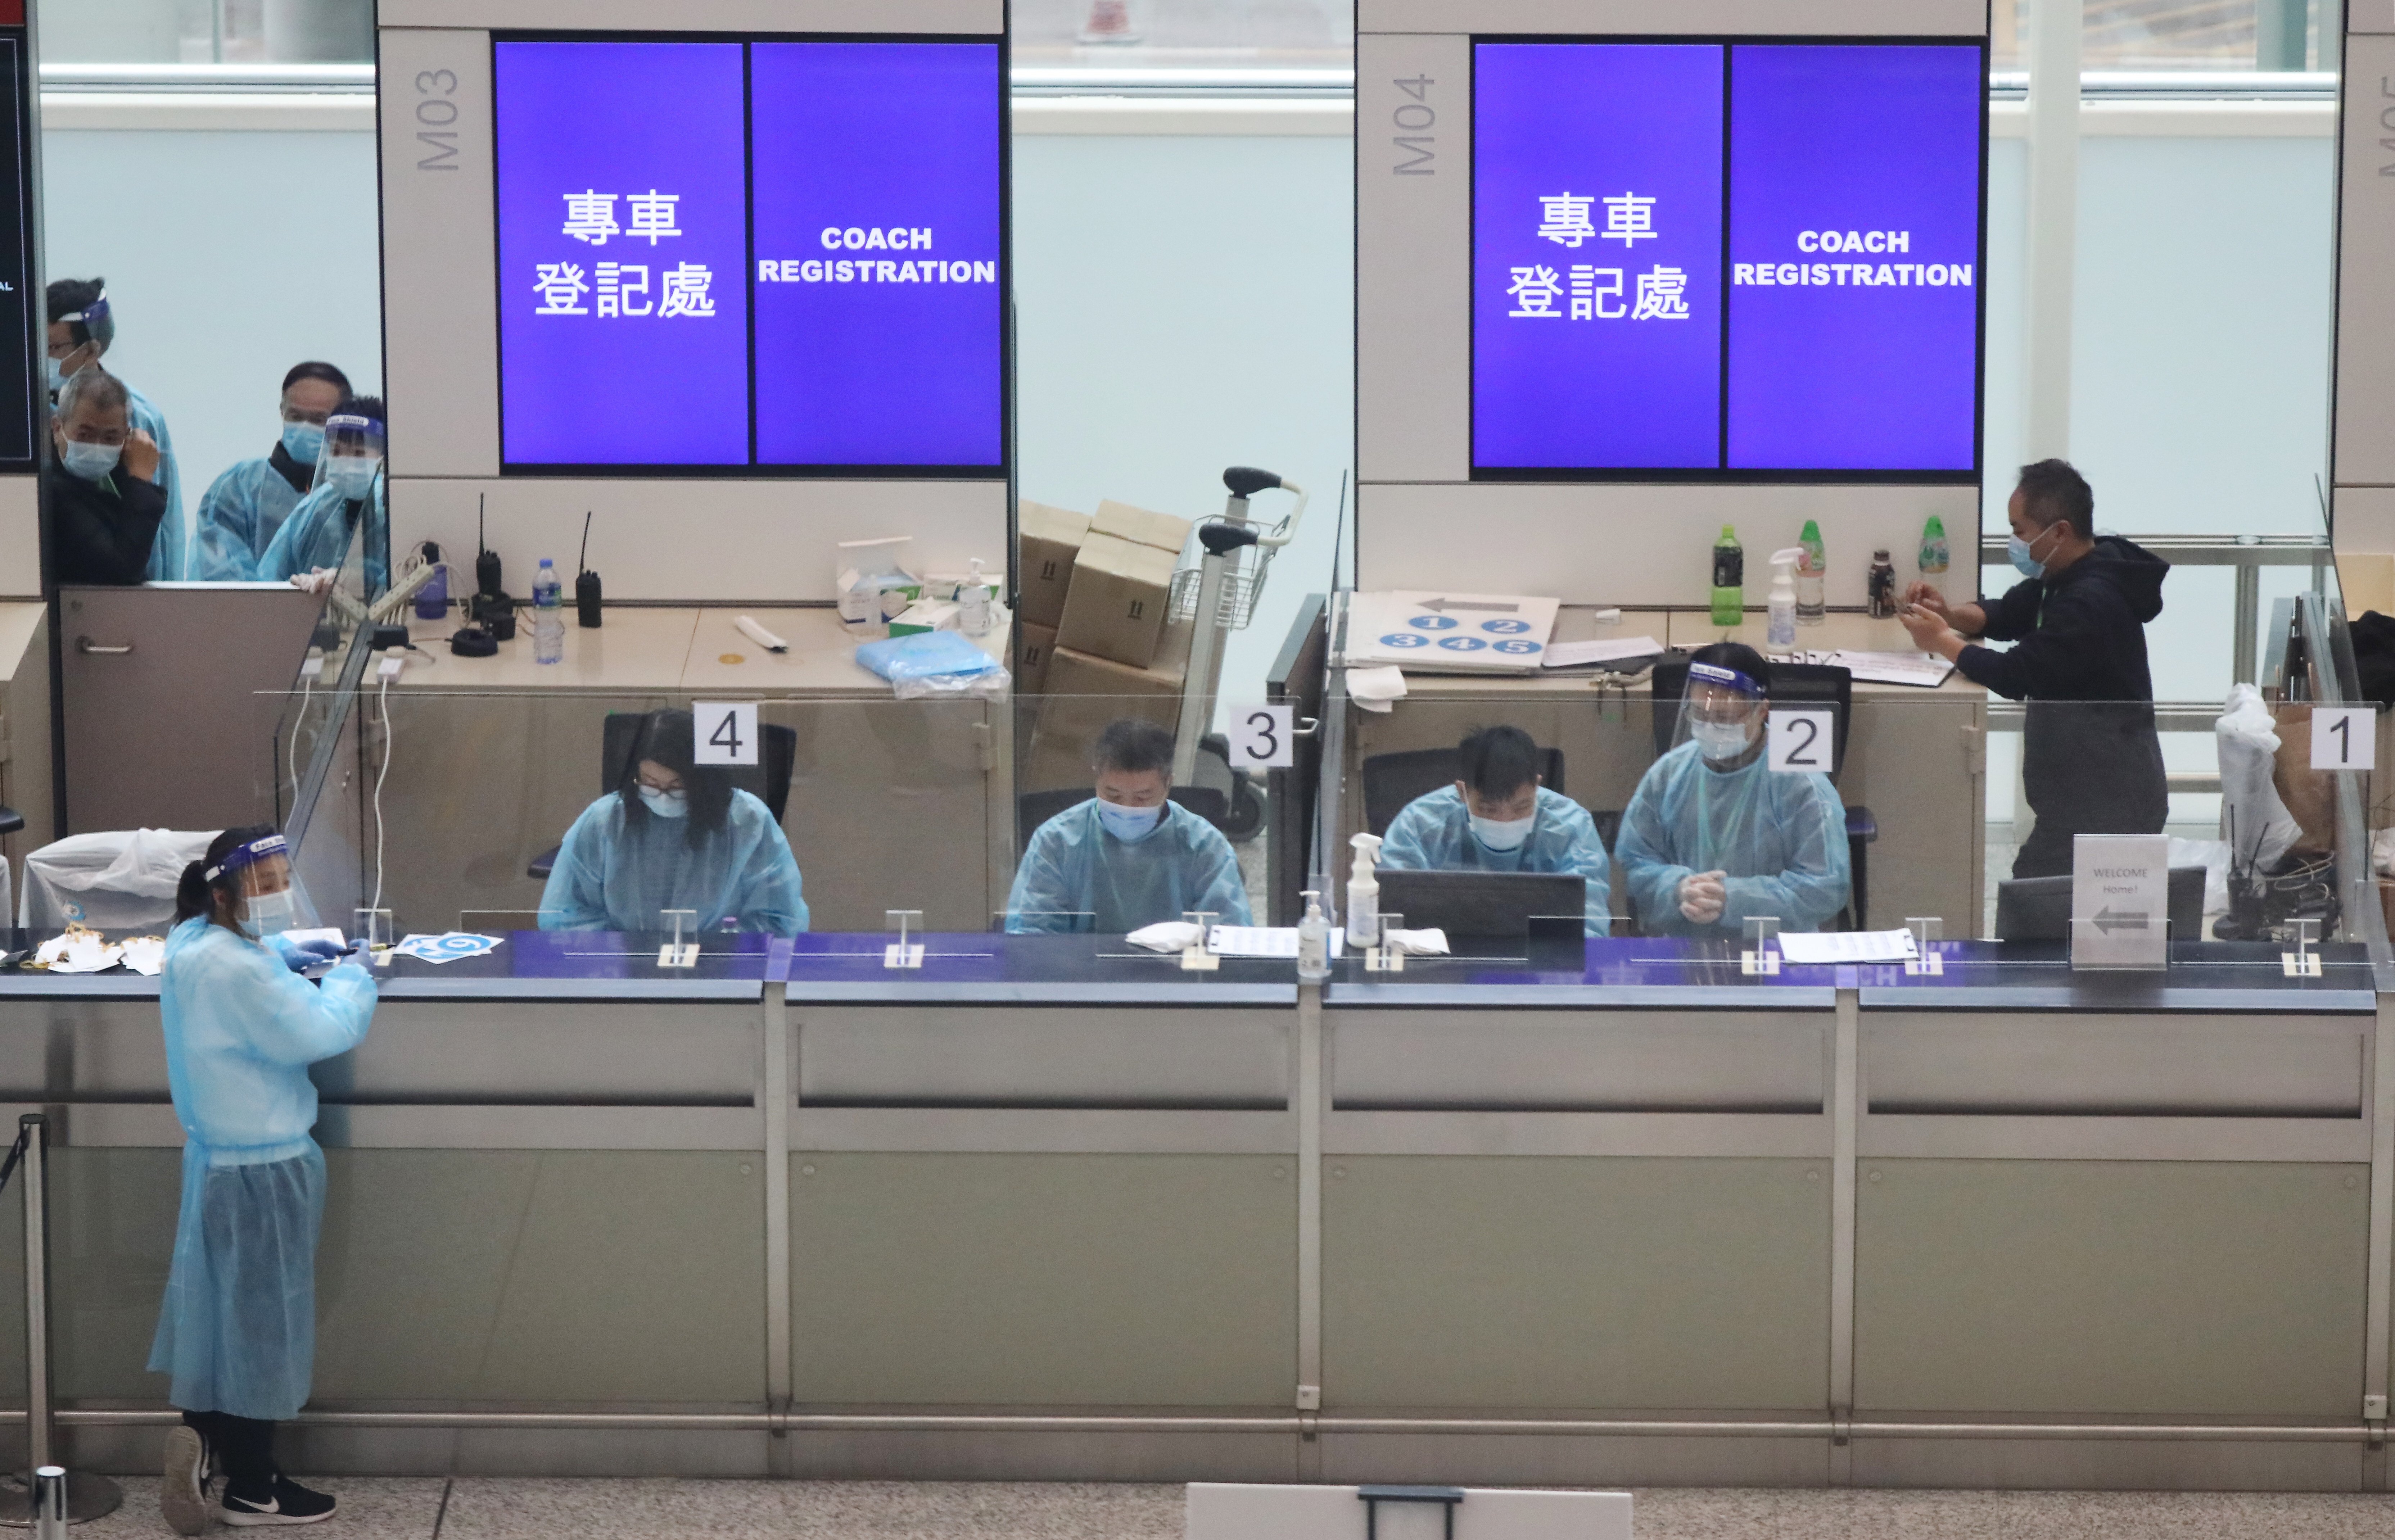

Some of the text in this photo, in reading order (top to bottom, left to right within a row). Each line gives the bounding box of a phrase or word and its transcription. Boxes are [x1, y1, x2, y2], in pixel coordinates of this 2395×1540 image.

[416, 69, 459, 171] M03
[1393, 73, 1436, 176] M04
[562, 189, 682, 246] 專車
[821, 227, 932, 250] COACH
[1537, 191, 1658, 248] 專車
[1797, 230, 1910, 253] COACH
[532, 261, 716, 318] 登記處
[758, 259, 995, 284] REGISTRATION
[1506, 264, 1690, 321] 登記處
[1734, 263, 1973, 287] REGISTRATION
[1393, 635, 1529, 653] 3 4 5
[1423, 616, 1518, 633] 1 2
[709, 710, 743, 758] 4
[1246, 711, 1278, 760] 3
[1785, 718, 1817, 765] 2
[2330, 715, 2349, 764] 1
[2093, 868, 2148, 878] WELCOME
[2103, 885, 2138, 894] Home!
